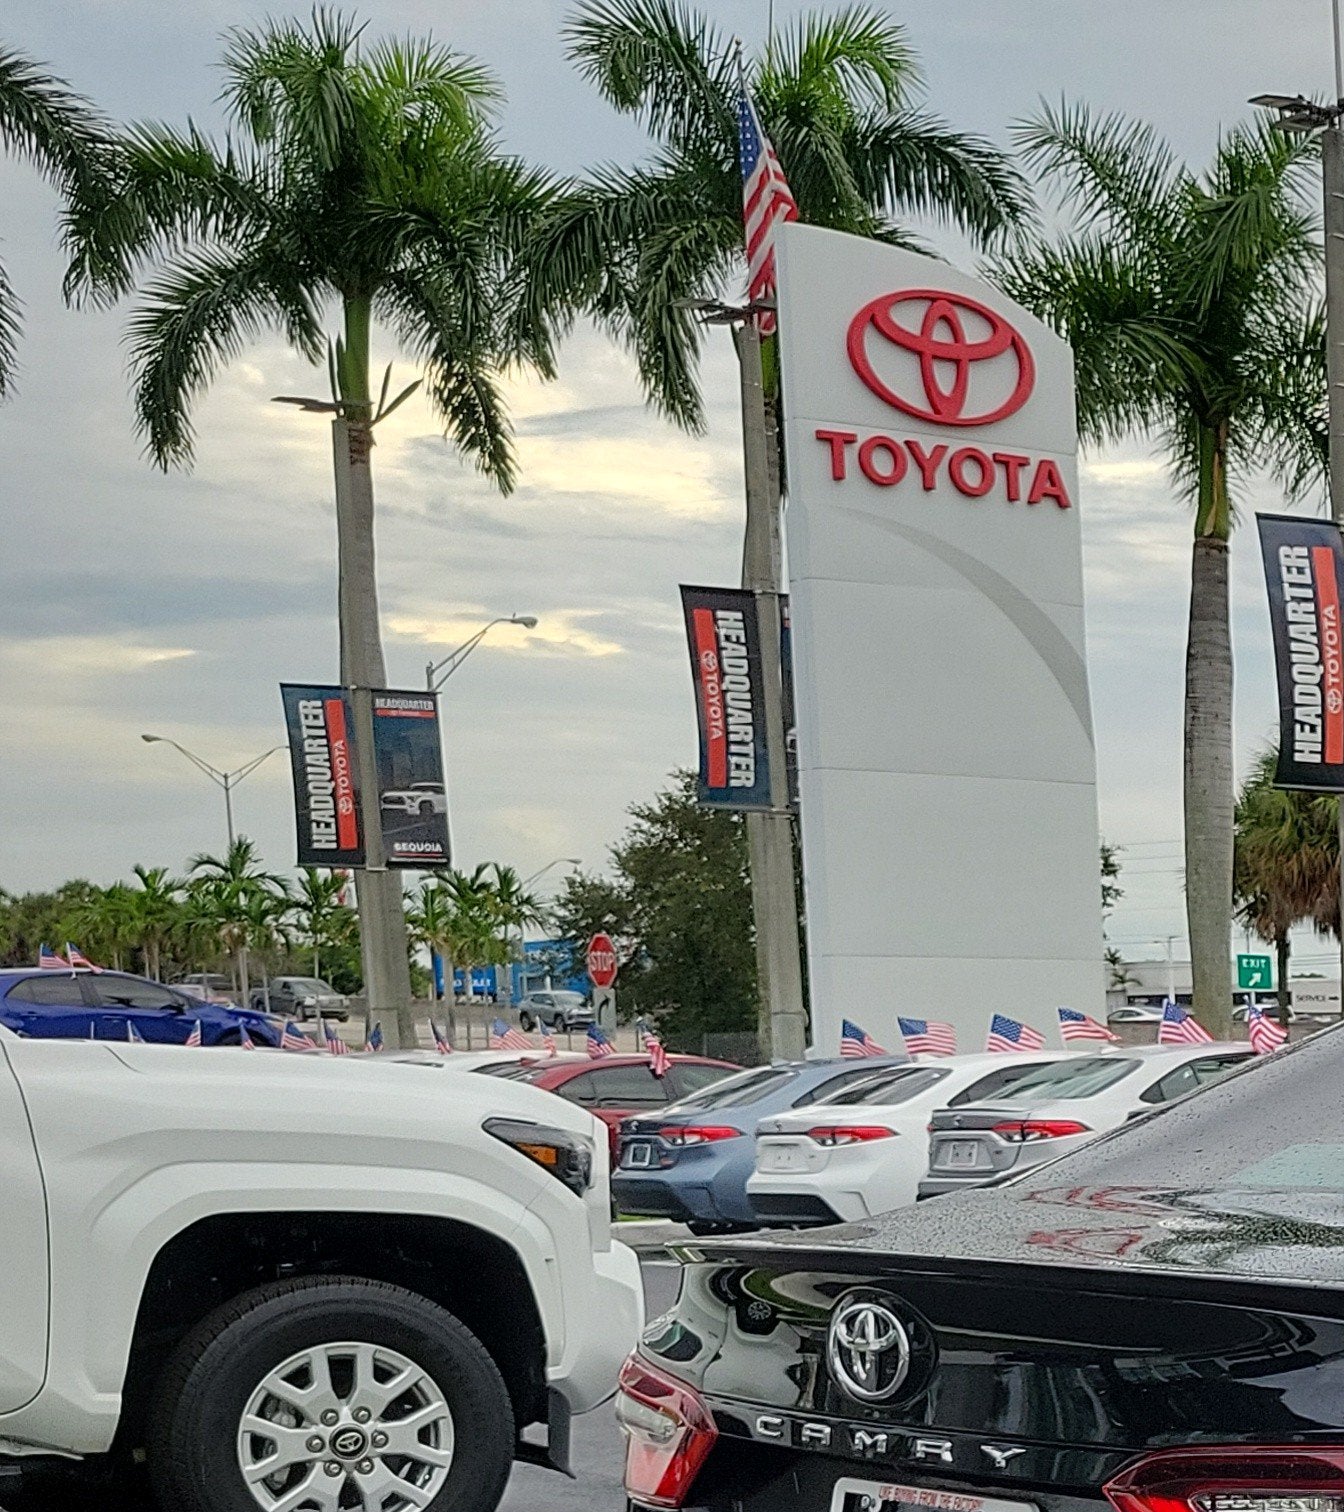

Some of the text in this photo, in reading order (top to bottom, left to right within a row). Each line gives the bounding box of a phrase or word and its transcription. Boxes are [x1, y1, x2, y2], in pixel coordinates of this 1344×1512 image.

[815, 429, 1071, 509] TOYOTA
[1278, 545, 1324, 764] HEADQUARTER
[1322, 604, 1341, 687] TOYOTA
[705, 671, 725, 740] TOYOTA
[715, 609, 756, 788] HEADQUARTER
[298, 699, 338, 849] HEADQUARTER
[333, 739, 352, 799] TOYOTA
[393, 842, 443, 853] SEQUOIA
[589, 951, 615, 971] STOP
[1242, 958, 1266, 969] EXIT
[756, 1415, 1027, 1468] CAMRY
